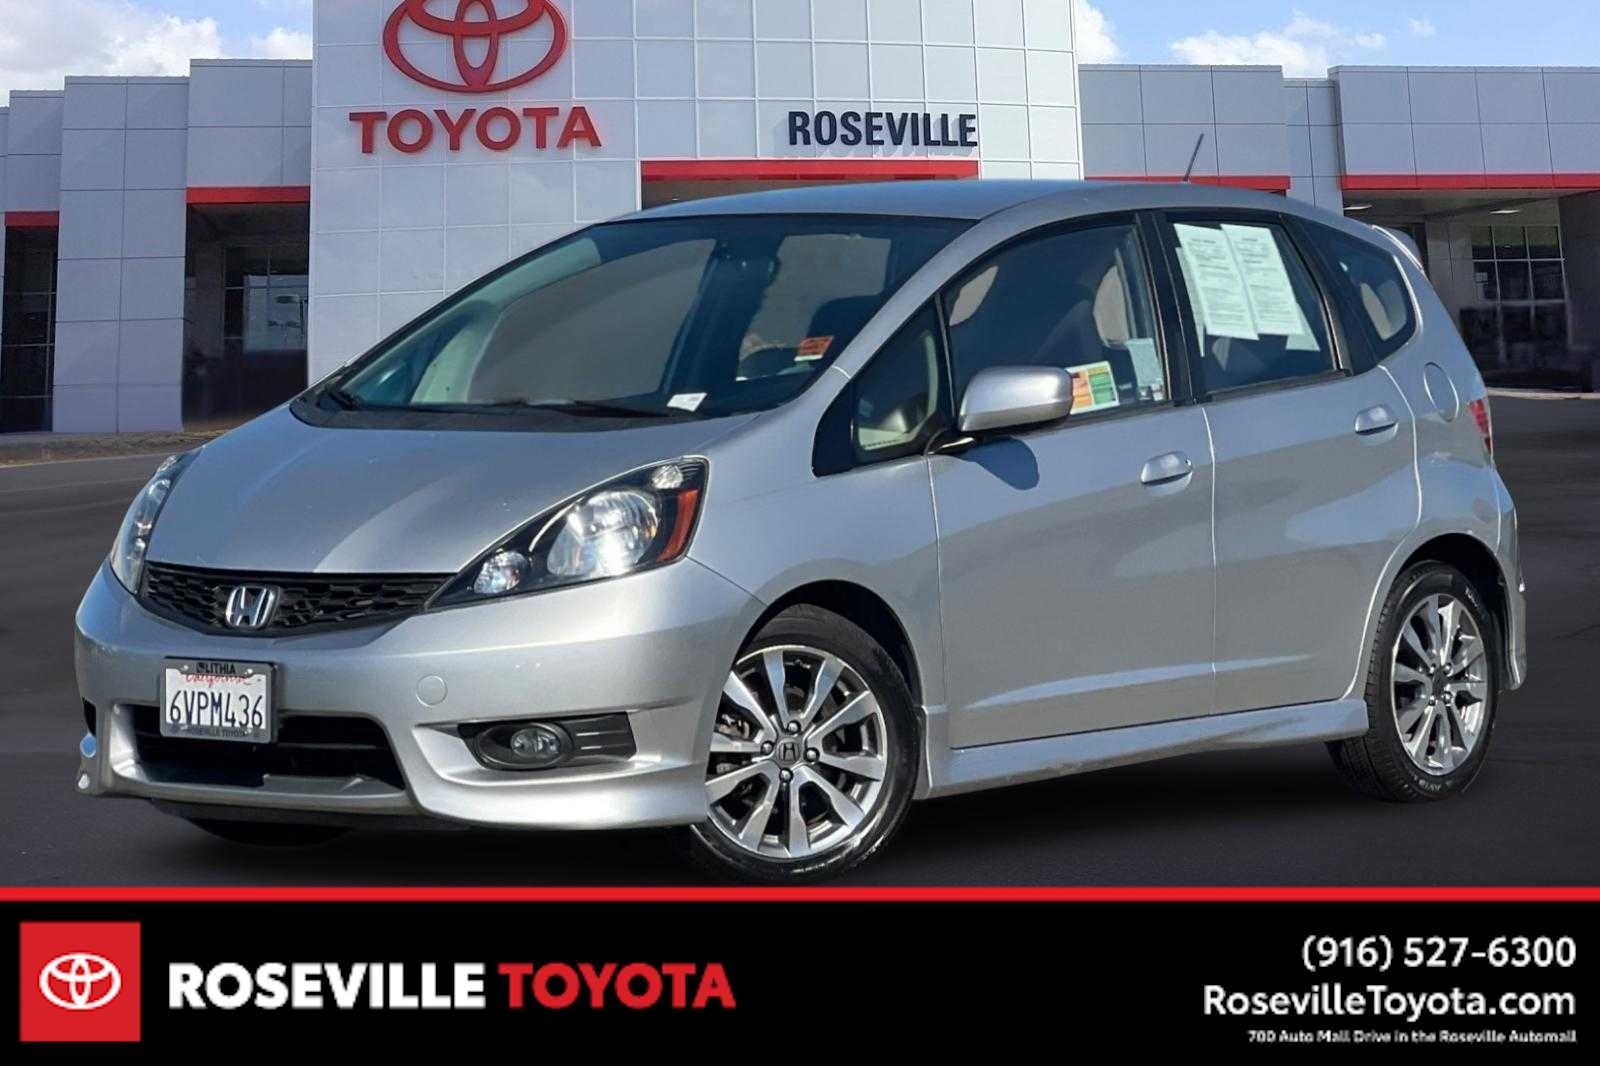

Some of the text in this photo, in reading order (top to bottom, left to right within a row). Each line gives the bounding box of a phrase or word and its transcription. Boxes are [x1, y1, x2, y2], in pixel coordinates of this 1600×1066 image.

[349, 106, 602, 154] TOYOTA
[788, 111, 978, 147] ROSEVILLE
[206, 662, 236, 675] LITHIA
[169, 690, 263, 728] 6VPM436
